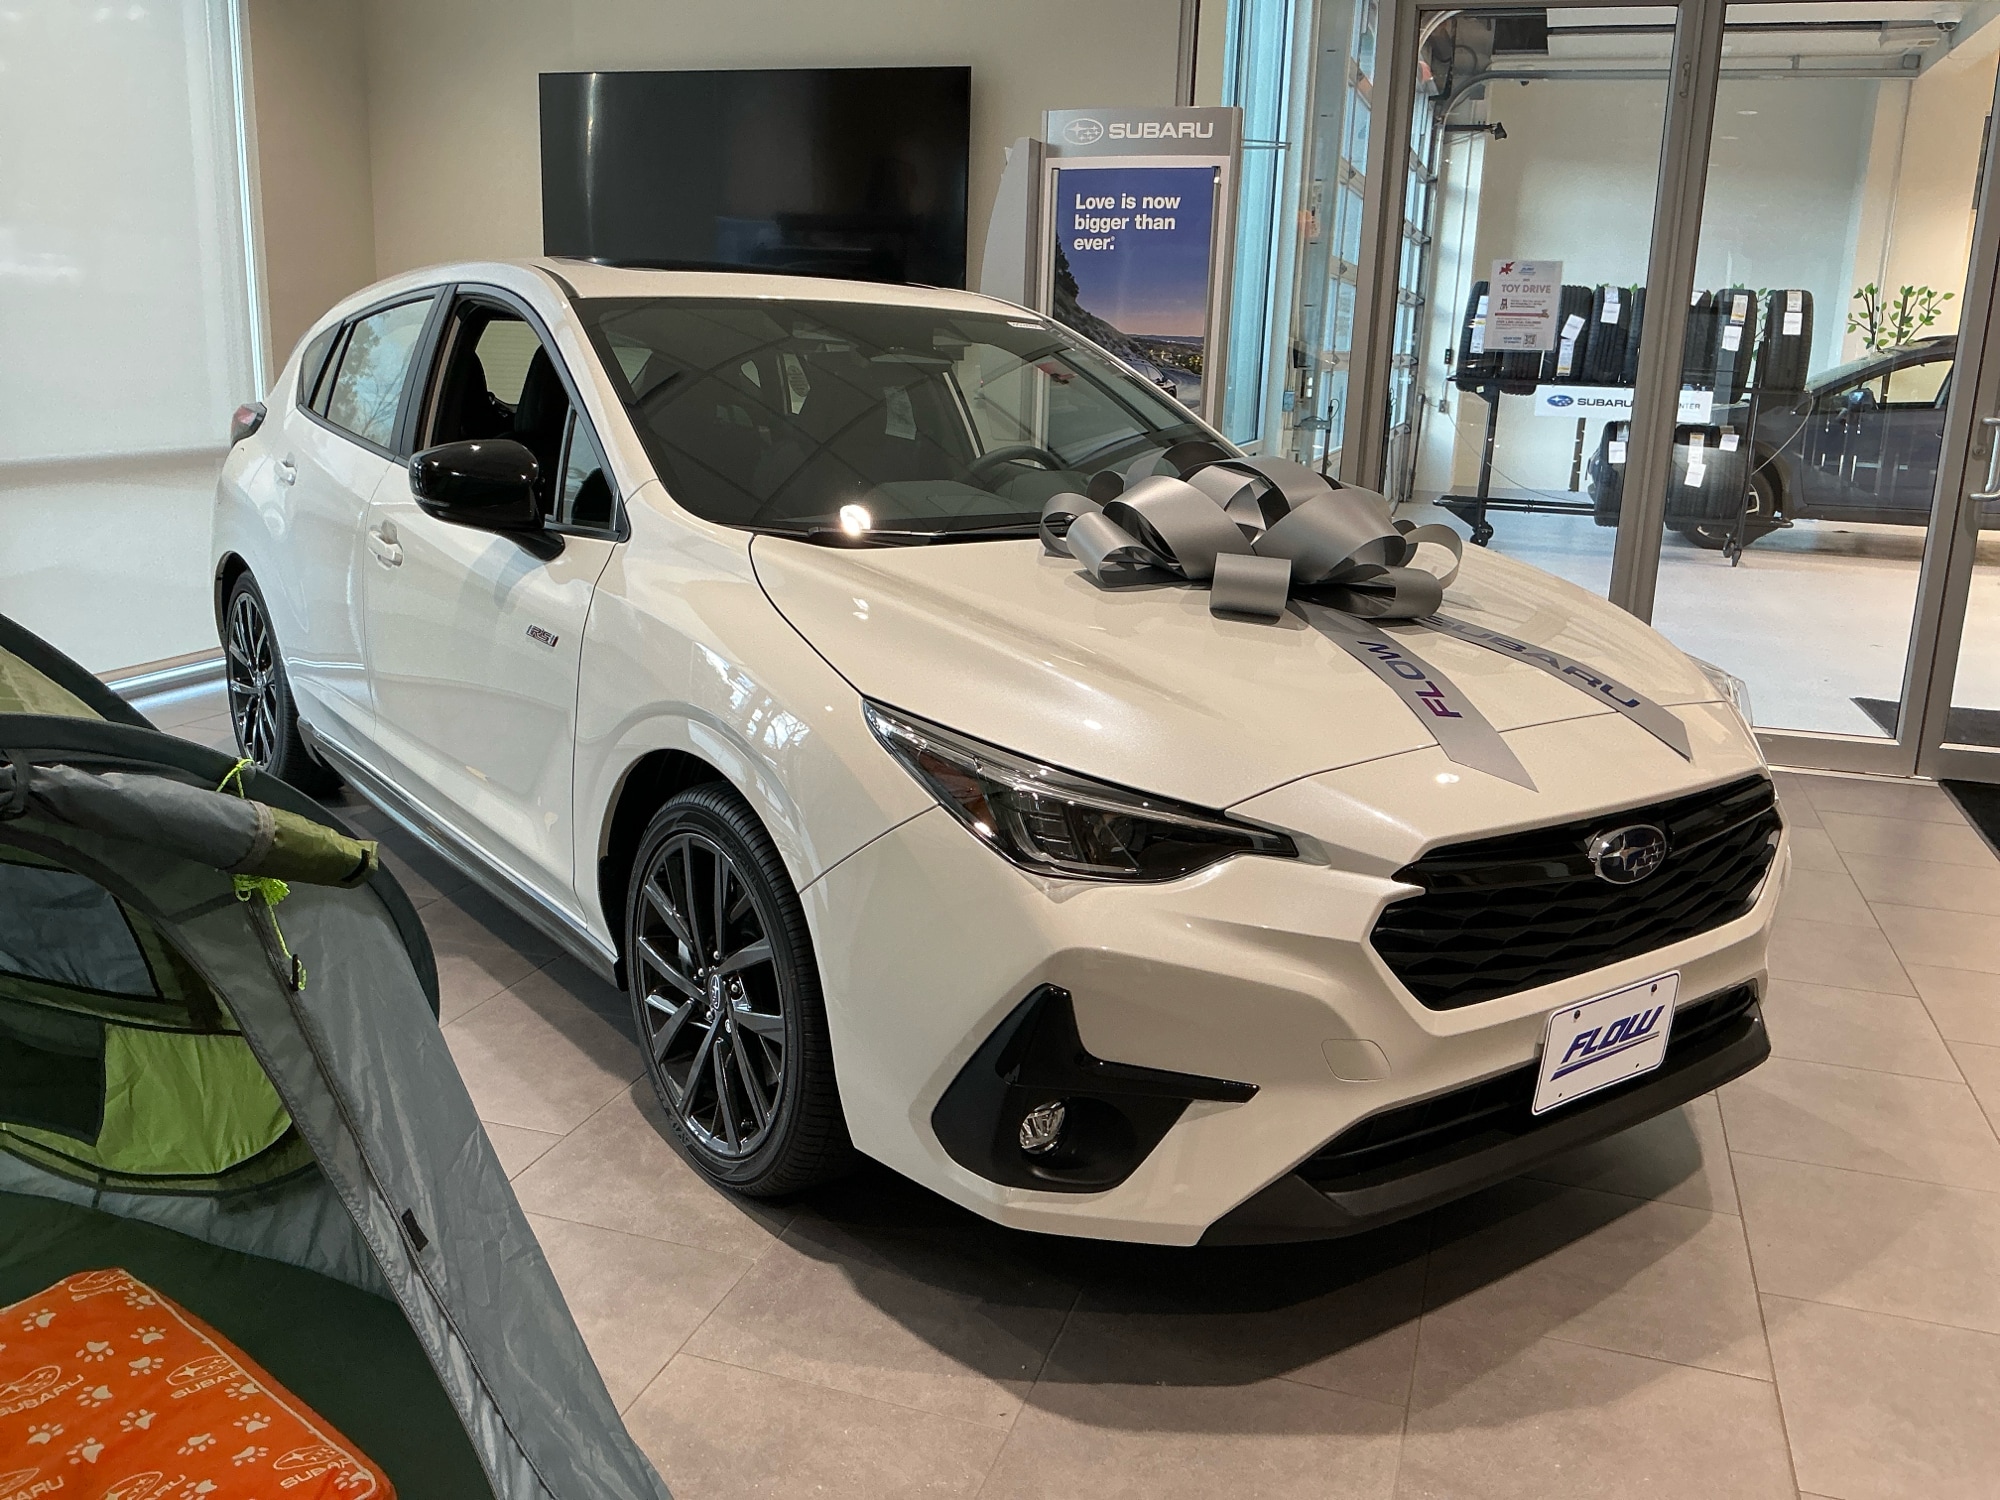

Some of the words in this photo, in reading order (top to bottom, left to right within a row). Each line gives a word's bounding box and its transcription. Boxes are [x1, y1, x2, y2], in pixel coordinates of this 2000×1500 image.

[1108, 122, 1213, 139] SUBARU
[1075, 194, 1115, 210] Love
[1121, 193, 1137, 209] is
[1142, 196, 1181, 209] now
[1074, 214, 1129, 232] bigger
[1134, 214, 1176, 230] than
[1501, 284, 1521, 293] TOY
[1522, 285, 1551, 294] DRIVE
[1577, 398, 1633, 408] SUBARU
[1420, 615, 1640, 709] SUBARU
[1357, 640, 1464, 719] FLOW
[1561, 1005, 1665, 1064] FLOW
